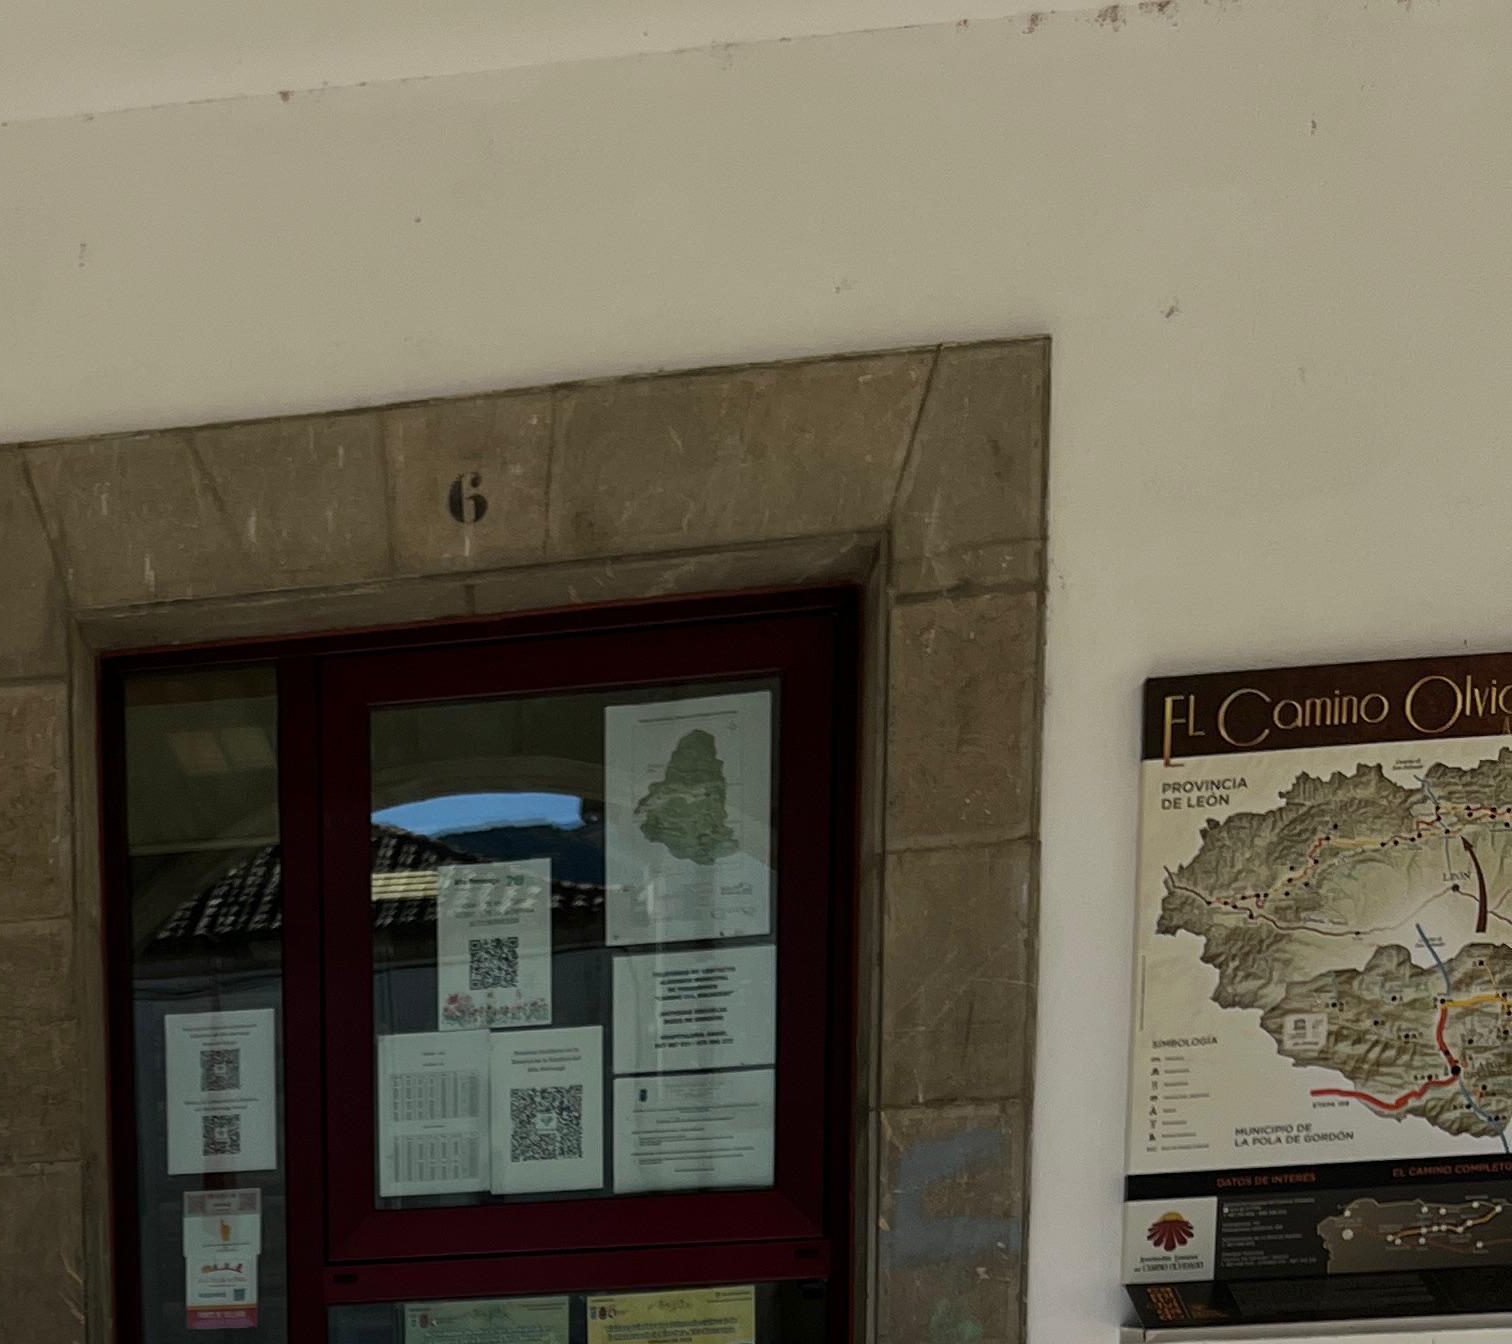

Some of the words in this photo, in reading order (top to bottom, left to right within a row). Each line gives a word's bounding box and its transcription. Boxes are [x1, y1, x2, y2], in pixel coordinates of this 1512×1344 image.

[449, 471, 488, 524] 6
[1162, 693, 1206, 768] EL
[1218, 688, 1389, 747] Camino
[1161, 777, 1249, 795] PROVINCIA
[1161, 797, 1183, 811] DE
[1187, 794, 1231, 808] LEÓN
[1152, 1034, 1218, 1049] SIMBOLOGÍA
[1235, 1124, 1294, 1136] MUNICIPIO
[1296, 1123, 1313, 1133] DE
[1235, 1137, 1249, 1148] LA
[1252, 1135, 1283, 1146] POLA
[1285, 1134, 1301, 1145] DE
[1303, 1130, 1355, 1143] GORDÓN
[1392, 1167, 1406, 1178] EL
[1408, 1164, 1453, 1177] CAMINO
[1216, 1176, 1252, 1188] DATOS
[1254, 1174, 1269, 1186] DE
